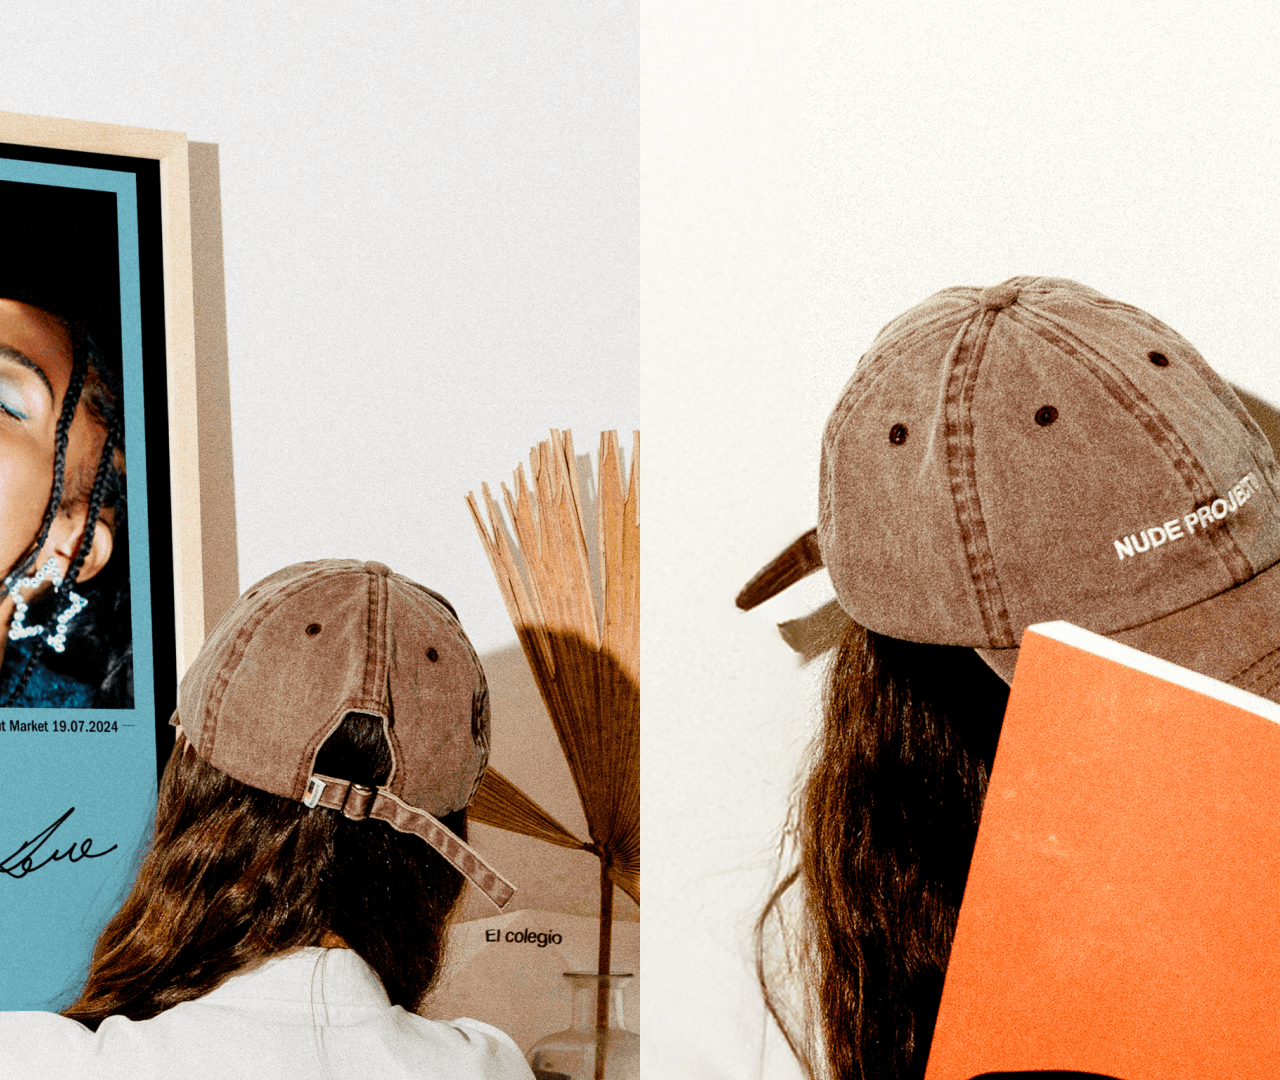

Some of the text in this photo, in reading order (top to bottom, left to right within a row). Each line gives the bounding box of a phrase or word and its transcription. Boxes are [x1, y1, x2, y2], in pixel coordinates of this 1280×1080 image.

[1114, 518, 1184, 560] NUDE
[9, 720, 49, 732] Market
[52, 720, 118, 733] 19.07.2024
[485, 928, 562, 948] El colegio
